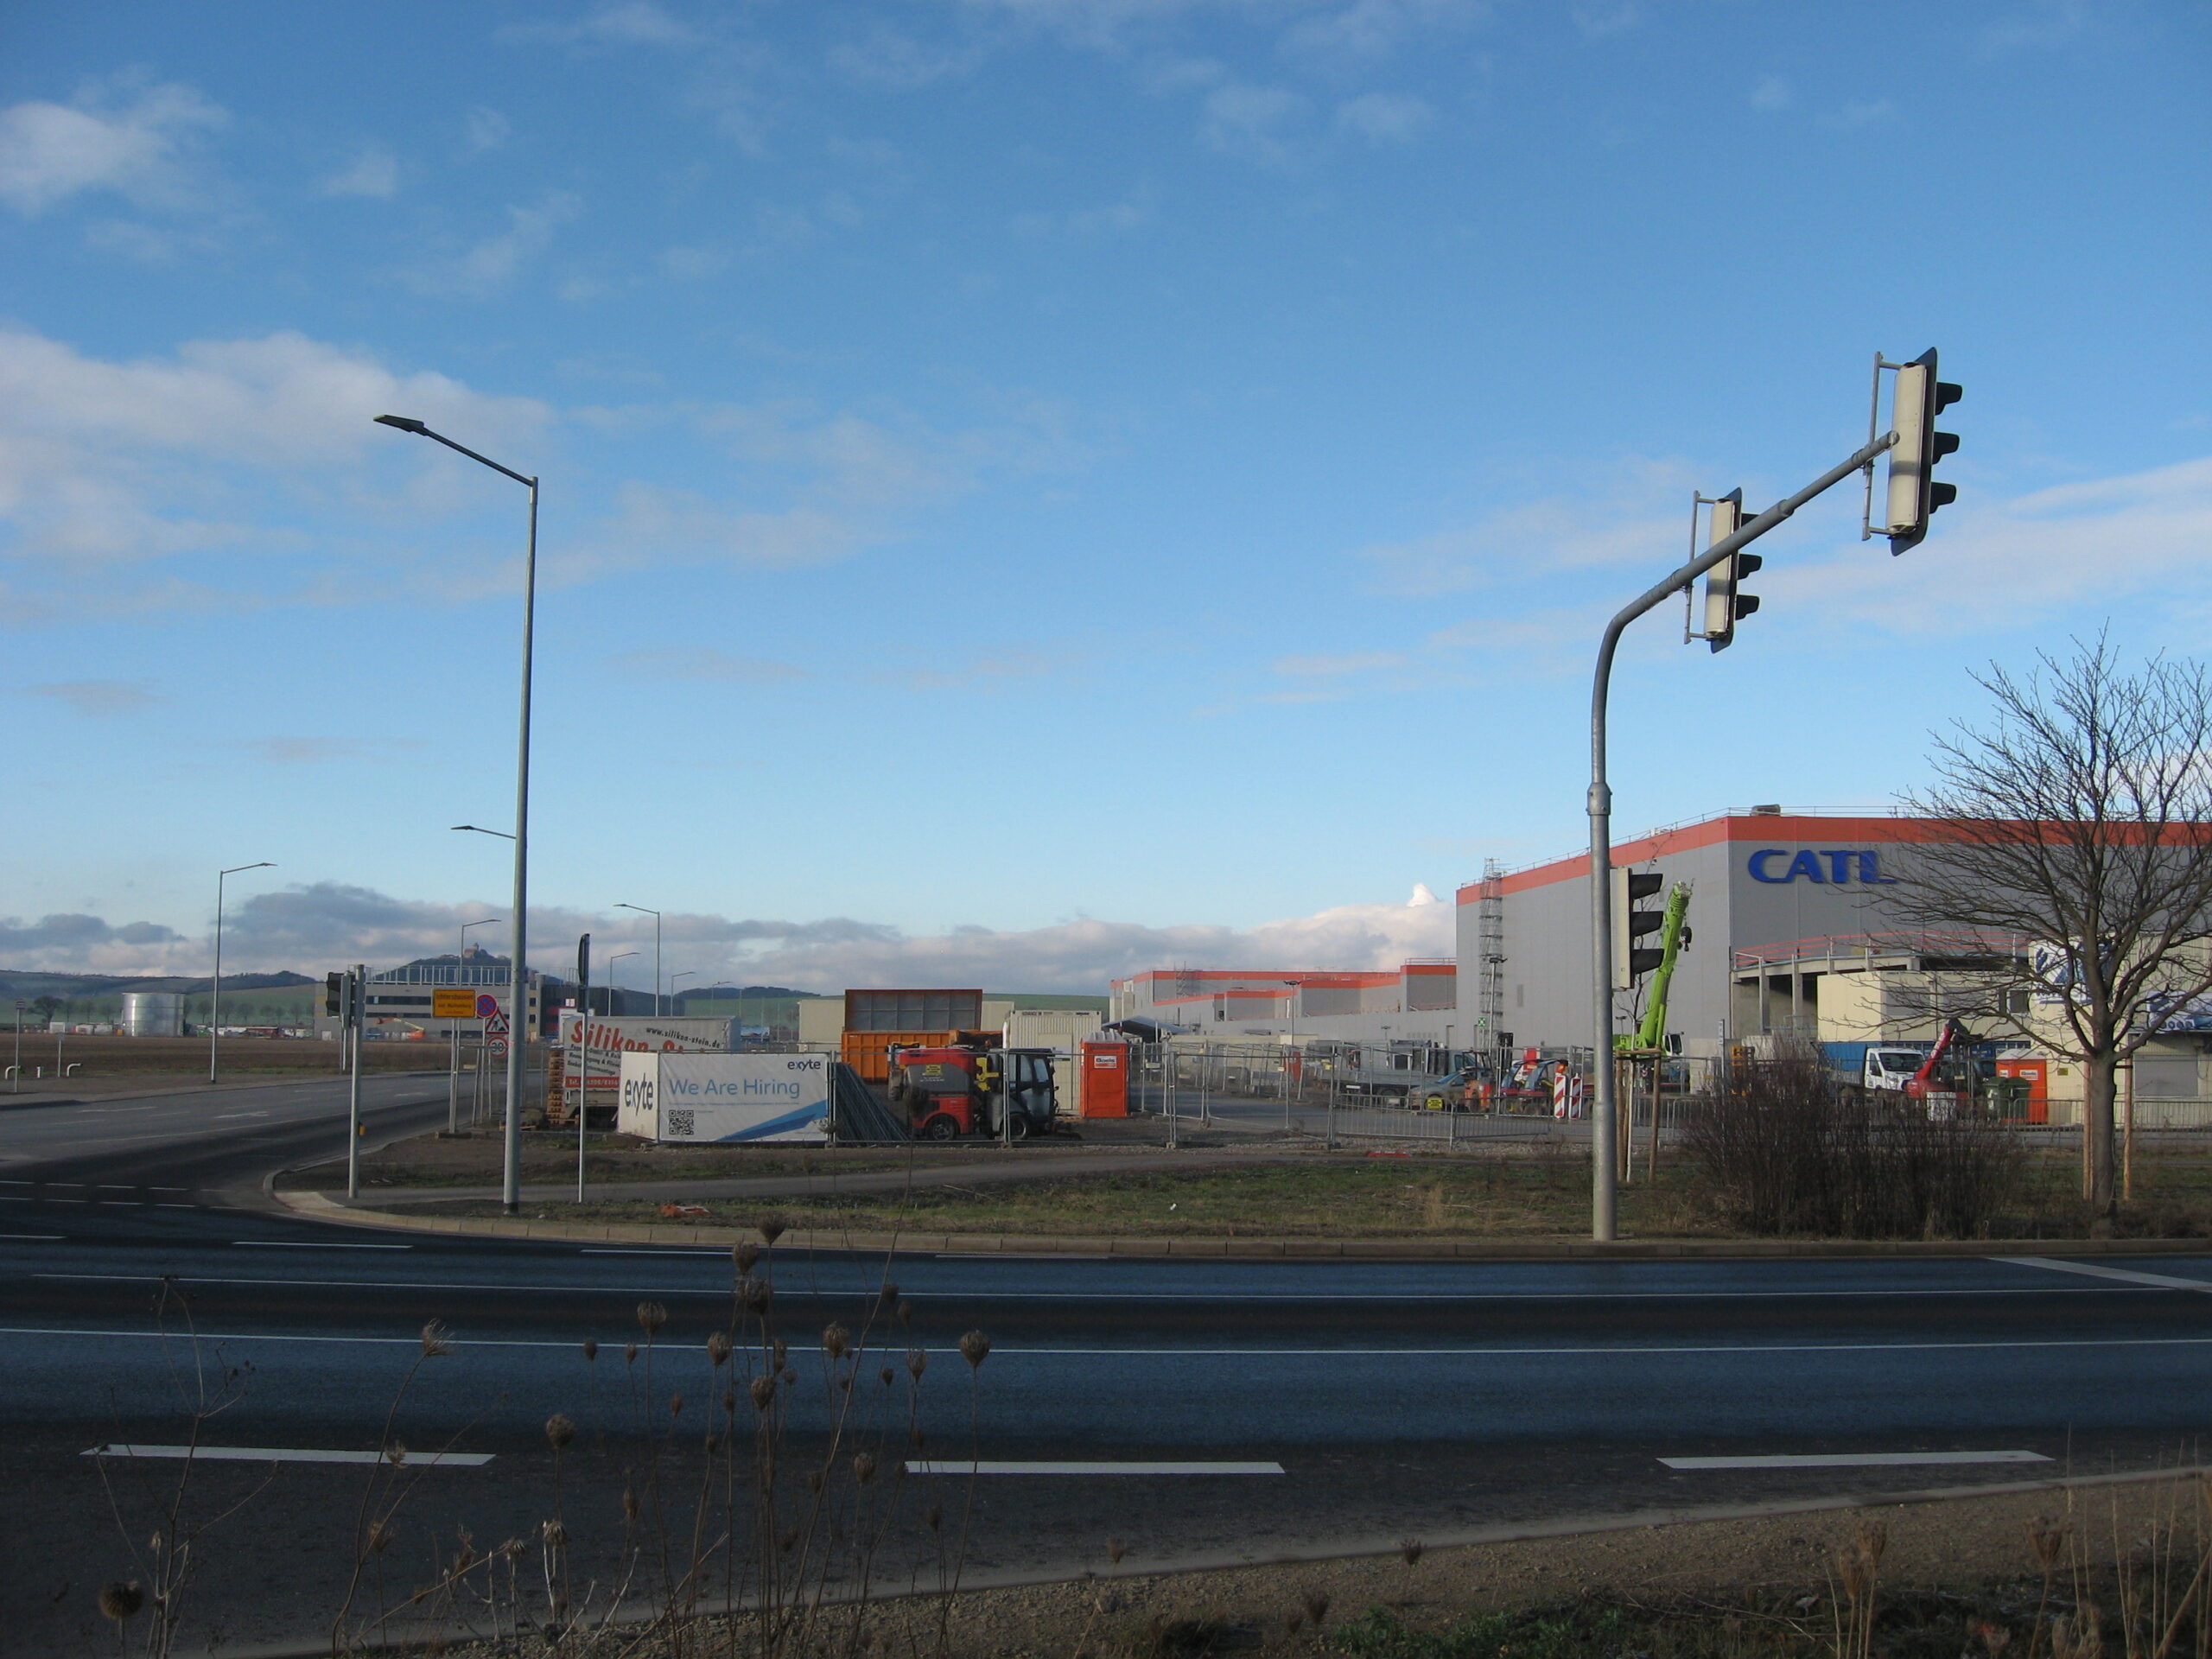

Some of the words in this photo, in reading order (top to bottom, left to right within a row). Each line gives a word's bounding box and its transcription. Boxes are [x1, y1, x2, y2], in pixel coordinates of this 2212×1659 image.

[1748, 849, 1898, 883] CATL
[491, 1042, 504, 1052] 30
[645, 1027, 721, 1049] www.silikon-stein.de
[787, 1058, 821, 1071] exyte
[625, 1072, 654, 1116] exyte
[670, 1079, 699, 1096] We
[704, 1079, 738, 1096] Are
[743, 1078, 801, 1100] Hiring
